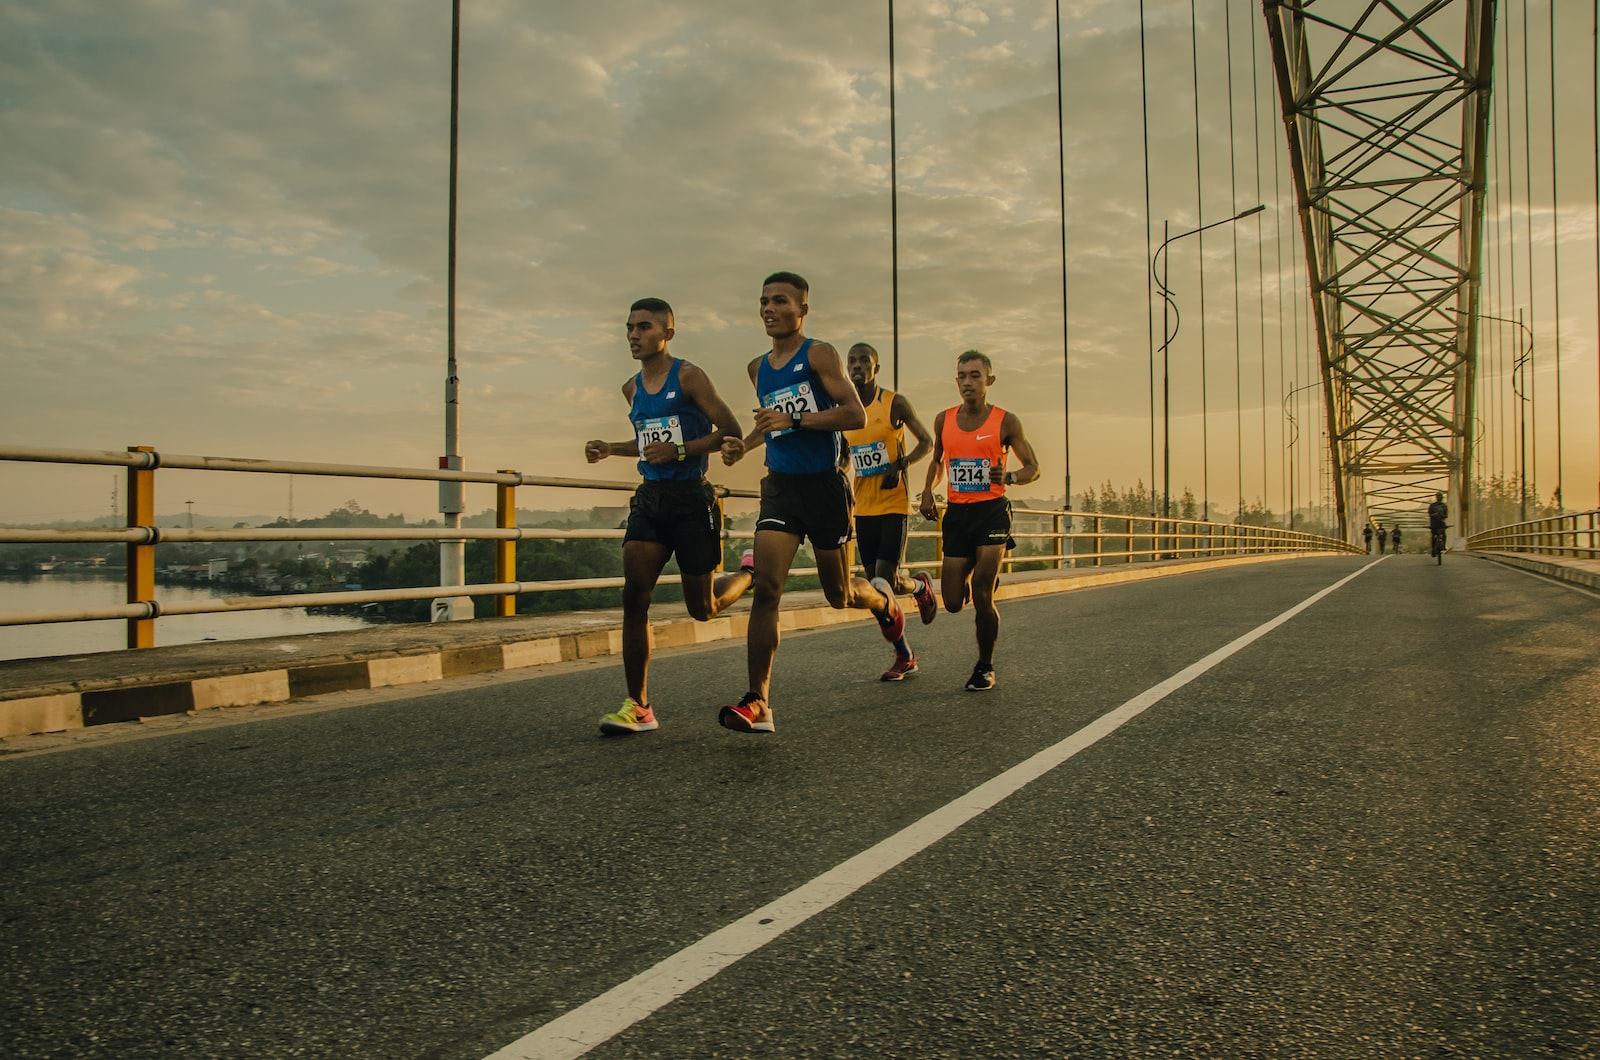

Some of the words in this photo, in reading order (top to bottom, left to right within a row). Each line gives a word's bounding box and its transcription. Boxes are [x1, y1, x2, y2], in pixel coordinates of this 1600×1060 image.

[643, 430, 674, 447] 1182
[854, 452, 882, 467] 1109
[953, 468, 984, 482] 1214
